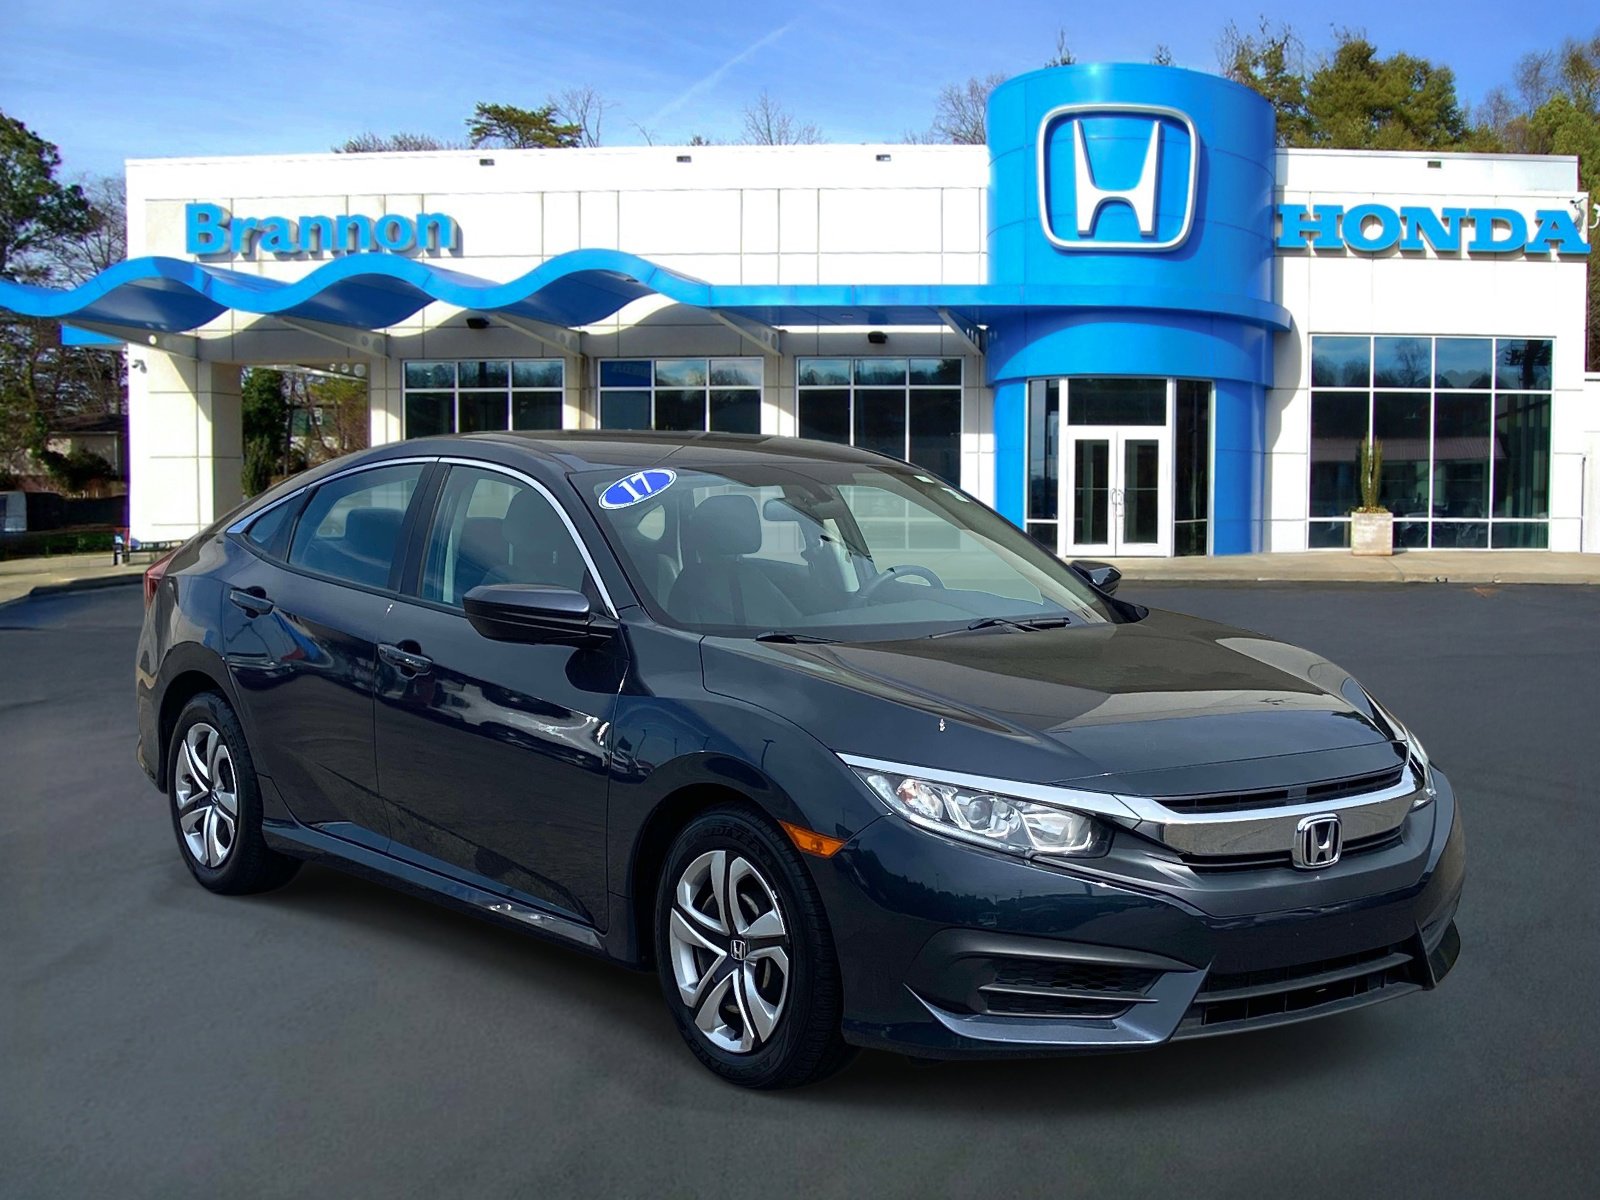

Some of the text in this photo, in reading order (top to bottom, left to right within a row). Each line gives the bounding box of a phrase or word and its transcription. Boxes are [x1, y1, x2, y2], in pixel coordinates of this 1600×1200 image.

[186, 202, 457, 255] Brannon
[1277, 204, 1591, 254] HONDA
[618, 471, 653, 502] 17
